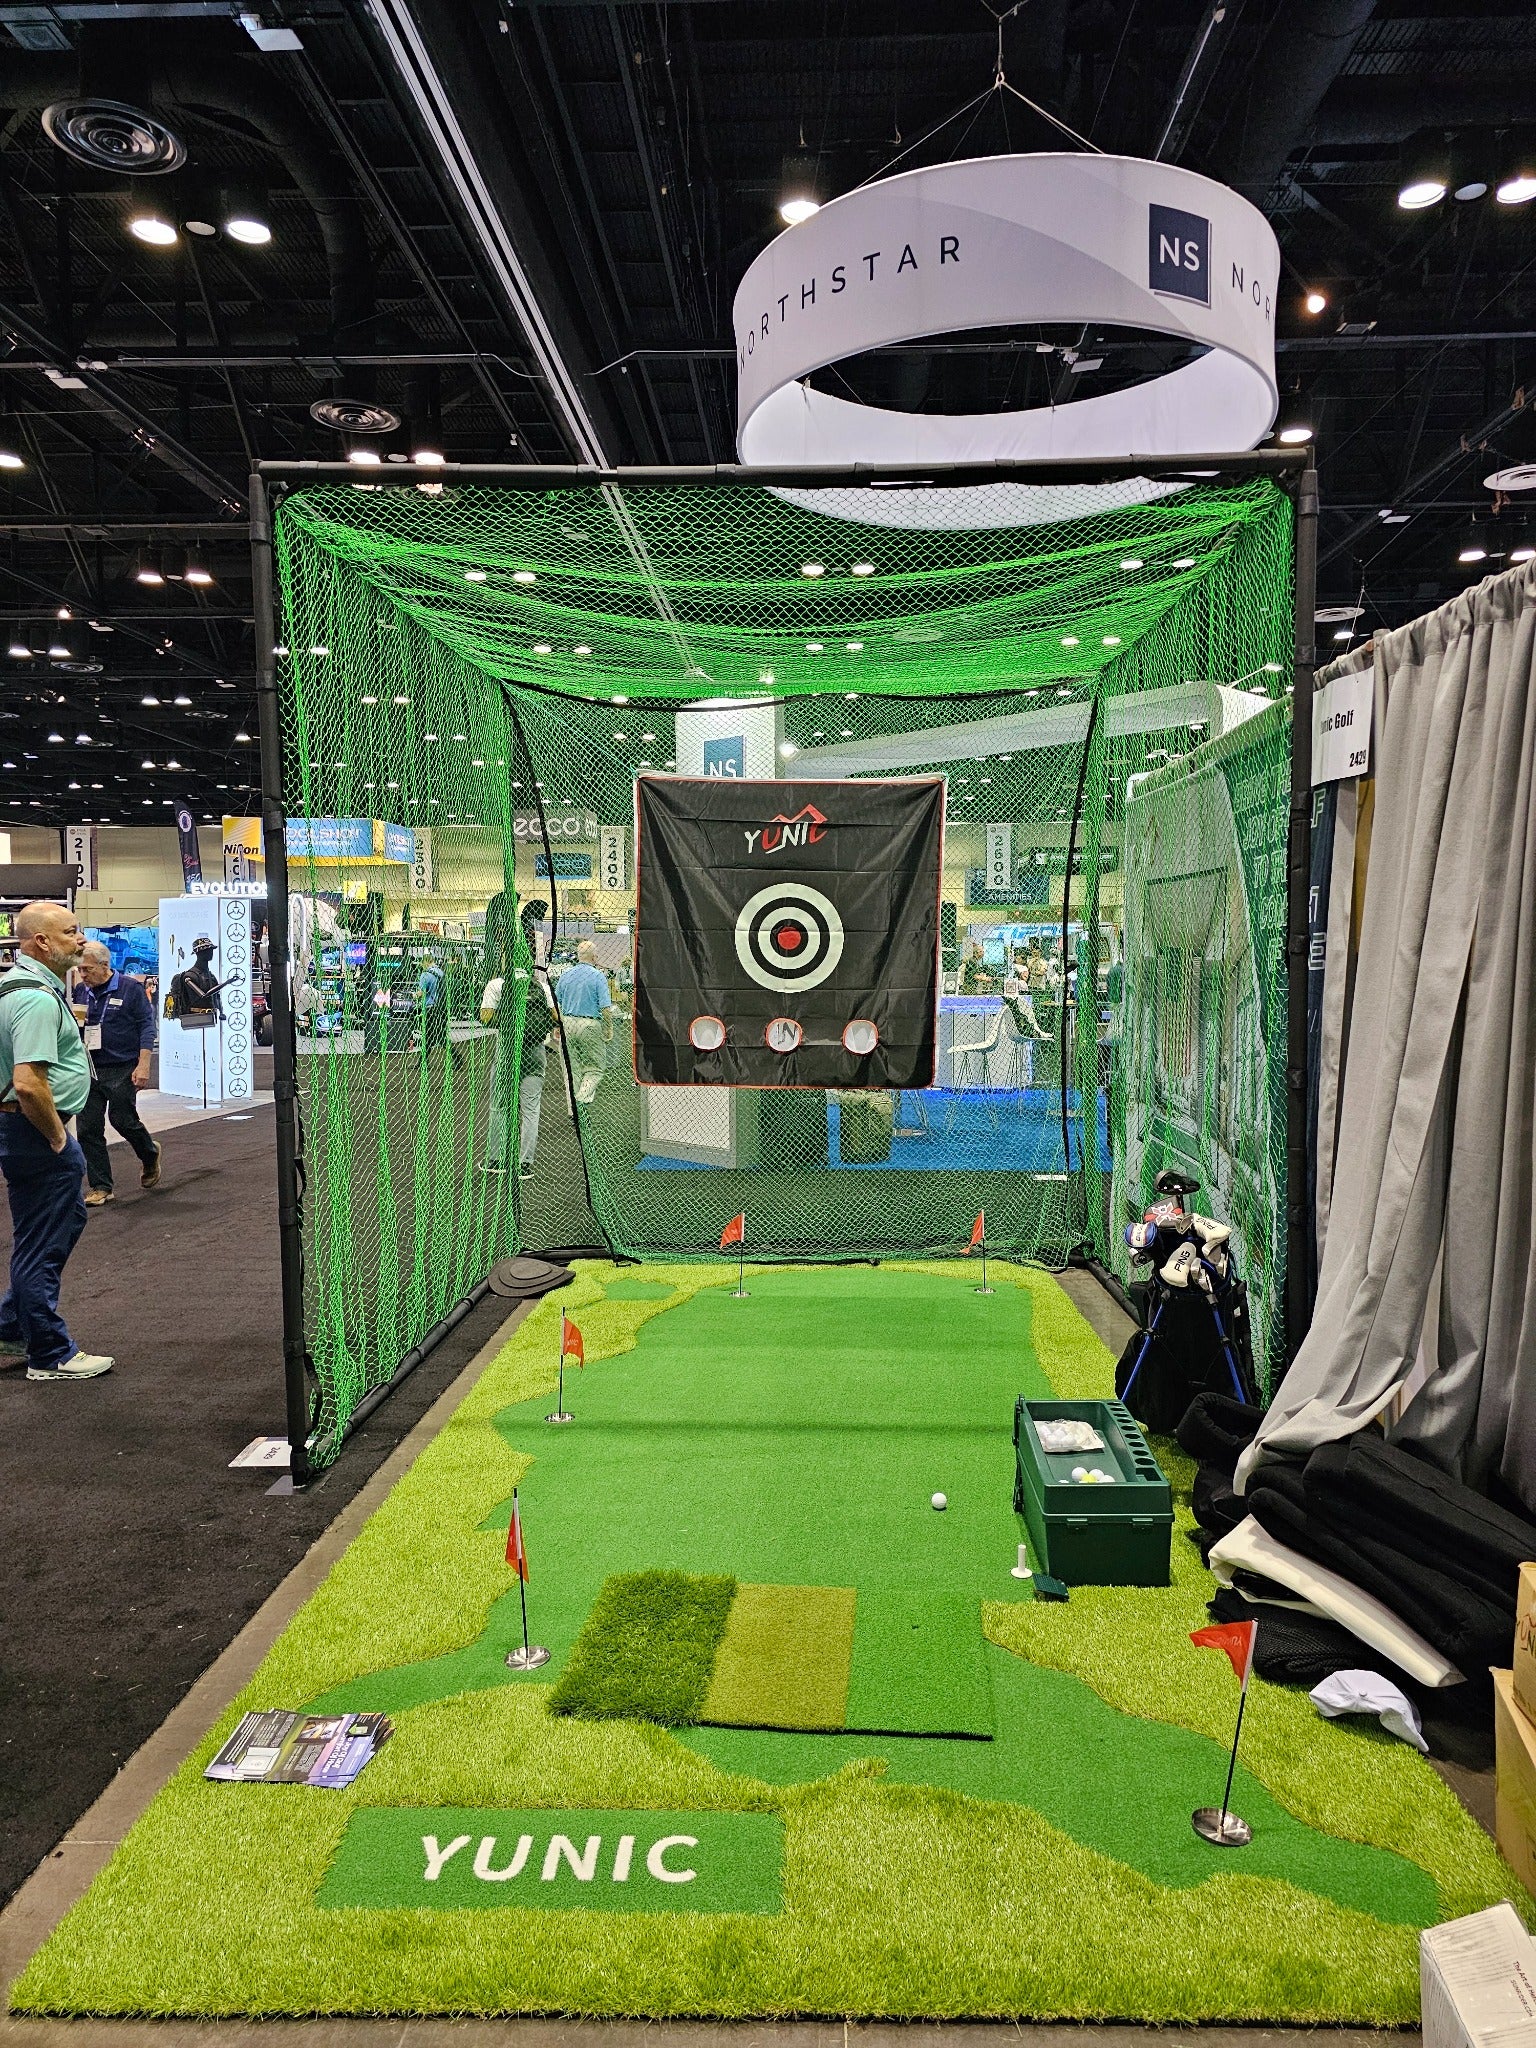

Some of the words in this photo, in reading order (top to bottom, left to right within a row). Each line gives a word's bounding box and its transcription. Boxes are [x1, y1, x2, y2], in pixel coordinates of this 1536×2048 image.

[1159, 232, 1200, 273] NS
[740, 236, 960, 375] NORTHSTAR
[1232, 261, 1275, 322] NOR
[1335, 710, 1354, 730] Golf
[1349, 749, 1367, 768] 2429
[744, 808, 829, 855] YUNIC
[607, 837, 618, 888] 2400
[989, 893, 1032, 901] AMENITIES
[1174, 1250, 1191, 1272] PING
[421, 1834, 700, 1883] YUNIC
